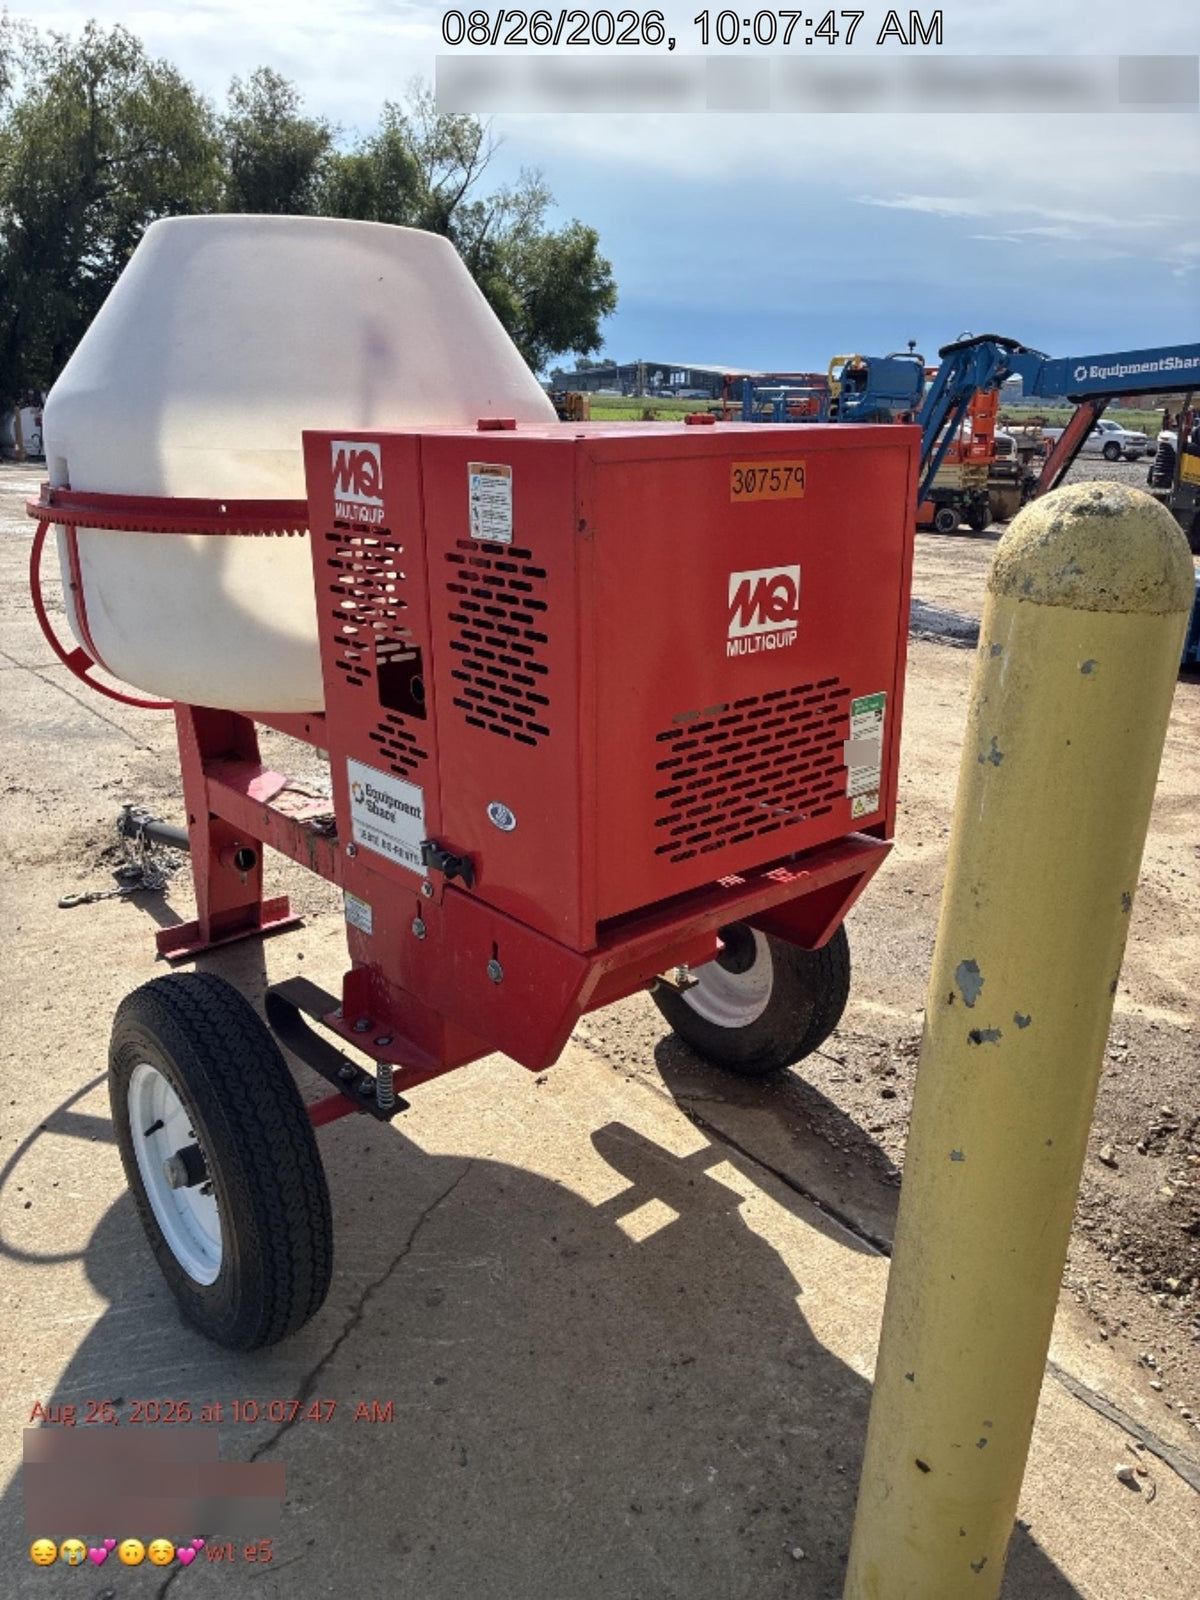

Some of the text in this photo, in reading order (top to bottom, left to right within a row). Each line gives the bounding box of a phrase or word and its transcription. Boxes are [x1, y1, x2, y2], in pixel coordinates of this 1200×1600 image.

[1088, 356, 1200, 379] EquipmentShar
[331, 446, 384, 499] MQ
[731, 466, 806, 495] 307579
[335, 502, 385, 524] MULTIQUIP
[728, 570, 800, 628] MQ
[726, 629, 798, 657] MULTIQUIP
[365, 783, 422, 820] Equipment
